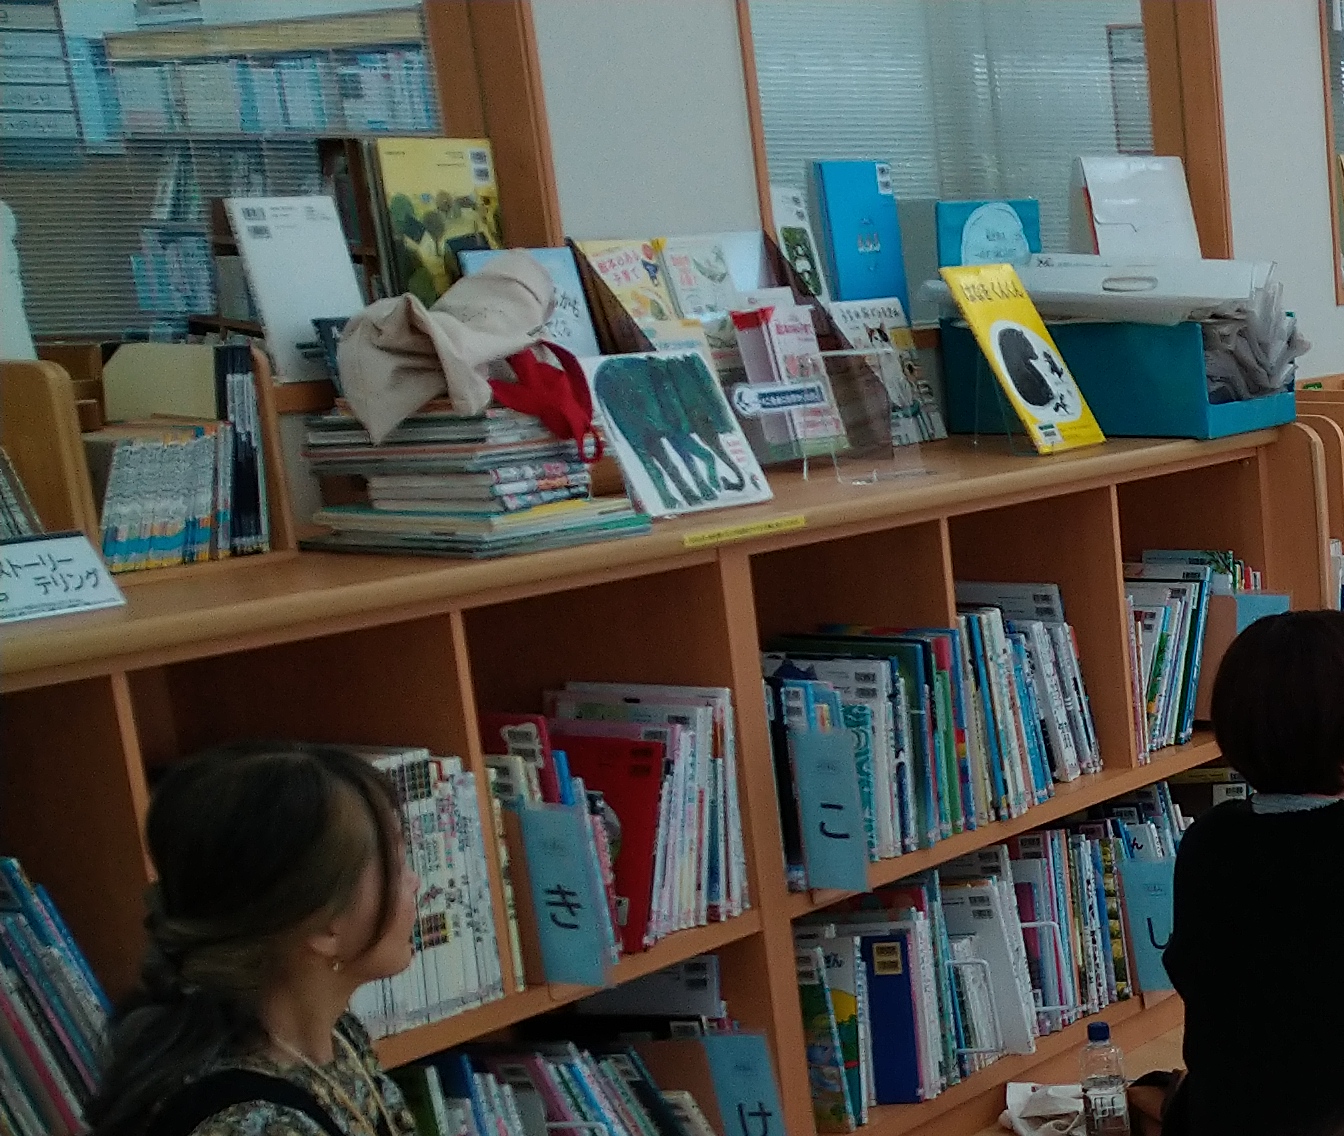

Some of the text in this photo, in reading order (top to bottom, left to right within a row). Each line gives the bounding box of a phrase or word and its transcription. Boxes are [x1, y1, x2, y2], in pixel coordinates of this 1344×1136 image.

[33, 566, 99, 596] テリング
[819, 801, 851, 839] こ
[543, 883, 583, 930] き
